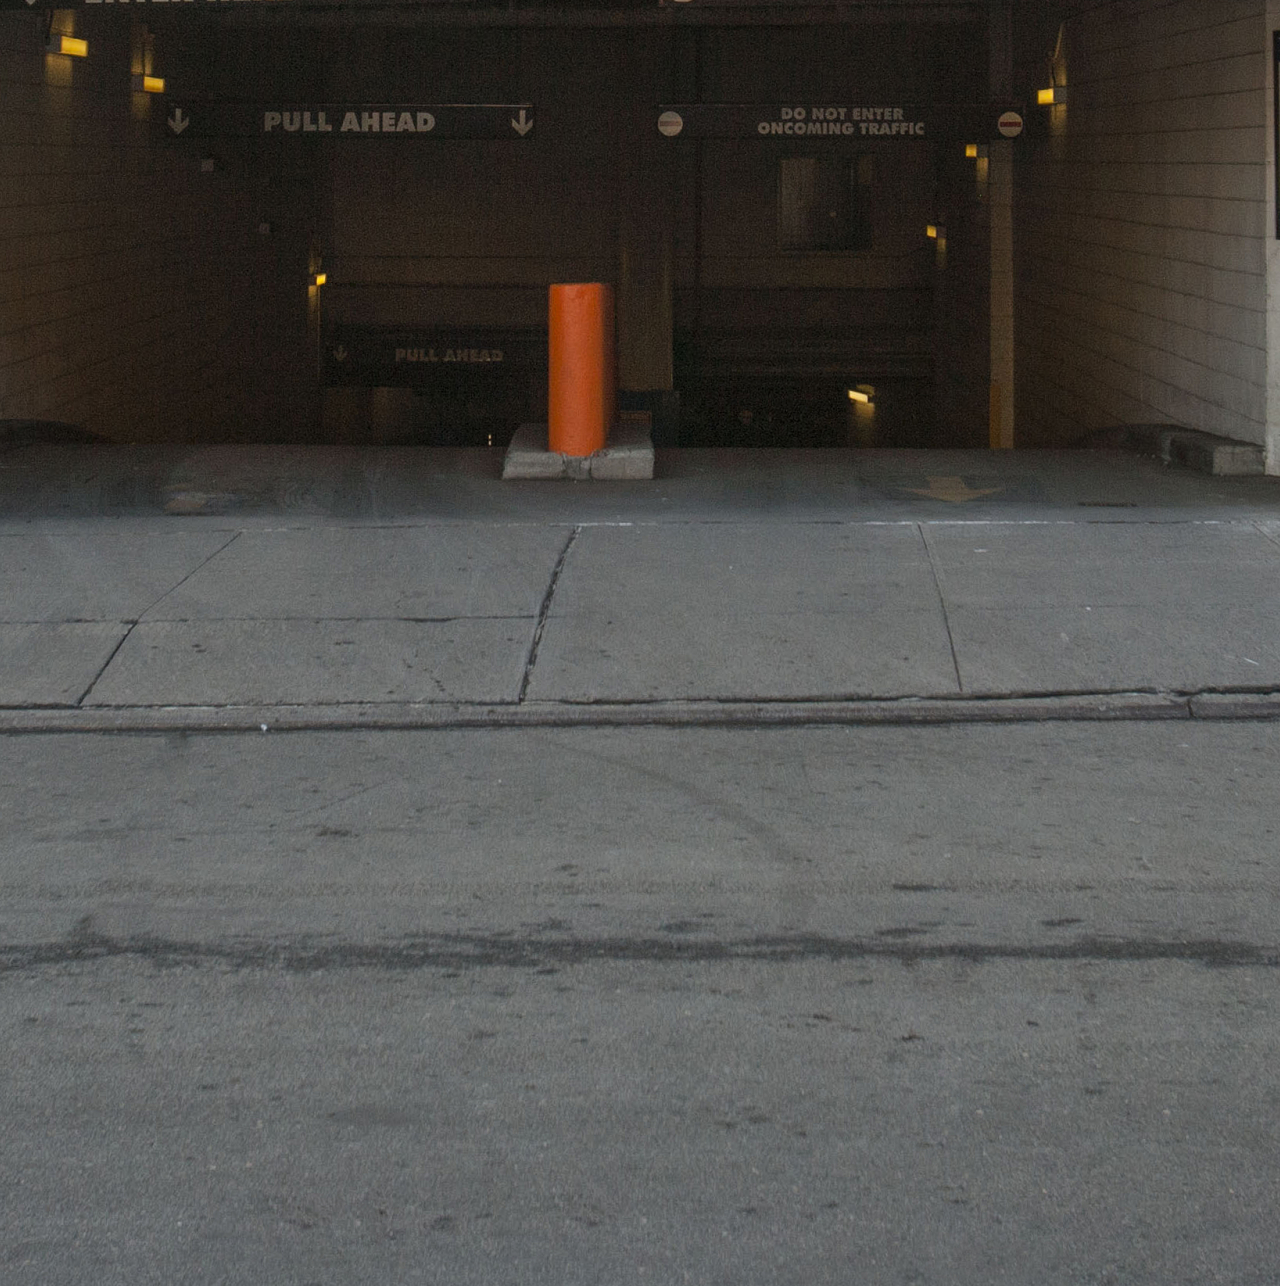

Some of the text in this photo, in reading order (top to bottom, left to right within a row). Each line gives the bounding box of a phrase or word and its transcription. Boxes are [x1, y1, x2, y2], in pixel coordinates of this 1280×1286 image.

[263, 112, 436, 133] PULL AHEAD
[780, 107, 905, 122] DO NOT ENTER
[757, 120, 926, 137] ONCOMING TRAFFIC
[394, 348, 504, 363] PULL AHEAD
